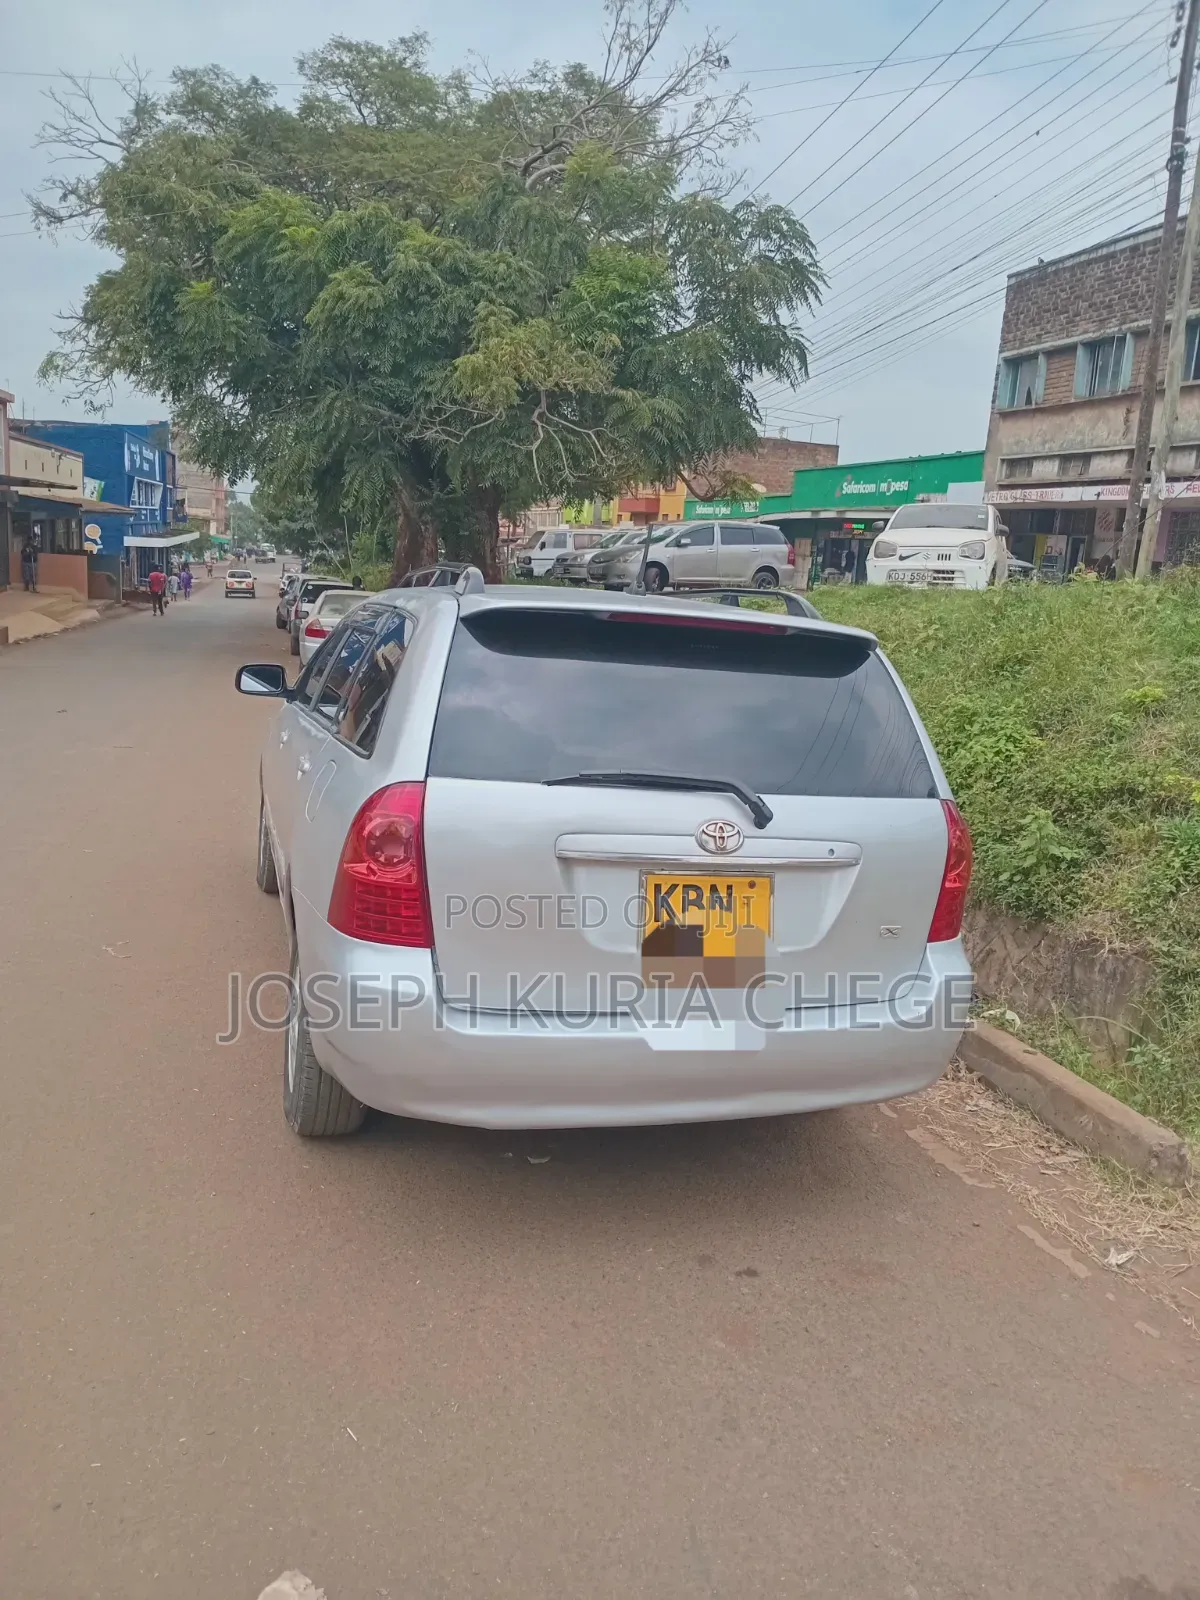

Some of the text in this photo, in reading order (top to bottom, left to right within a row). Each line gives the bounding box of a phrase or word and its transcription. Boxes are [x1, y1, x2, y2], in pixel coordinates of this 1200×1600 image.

[842, 481, 876, 494] Safaricom
[888, 572, 933, 581] KDJ 556H
